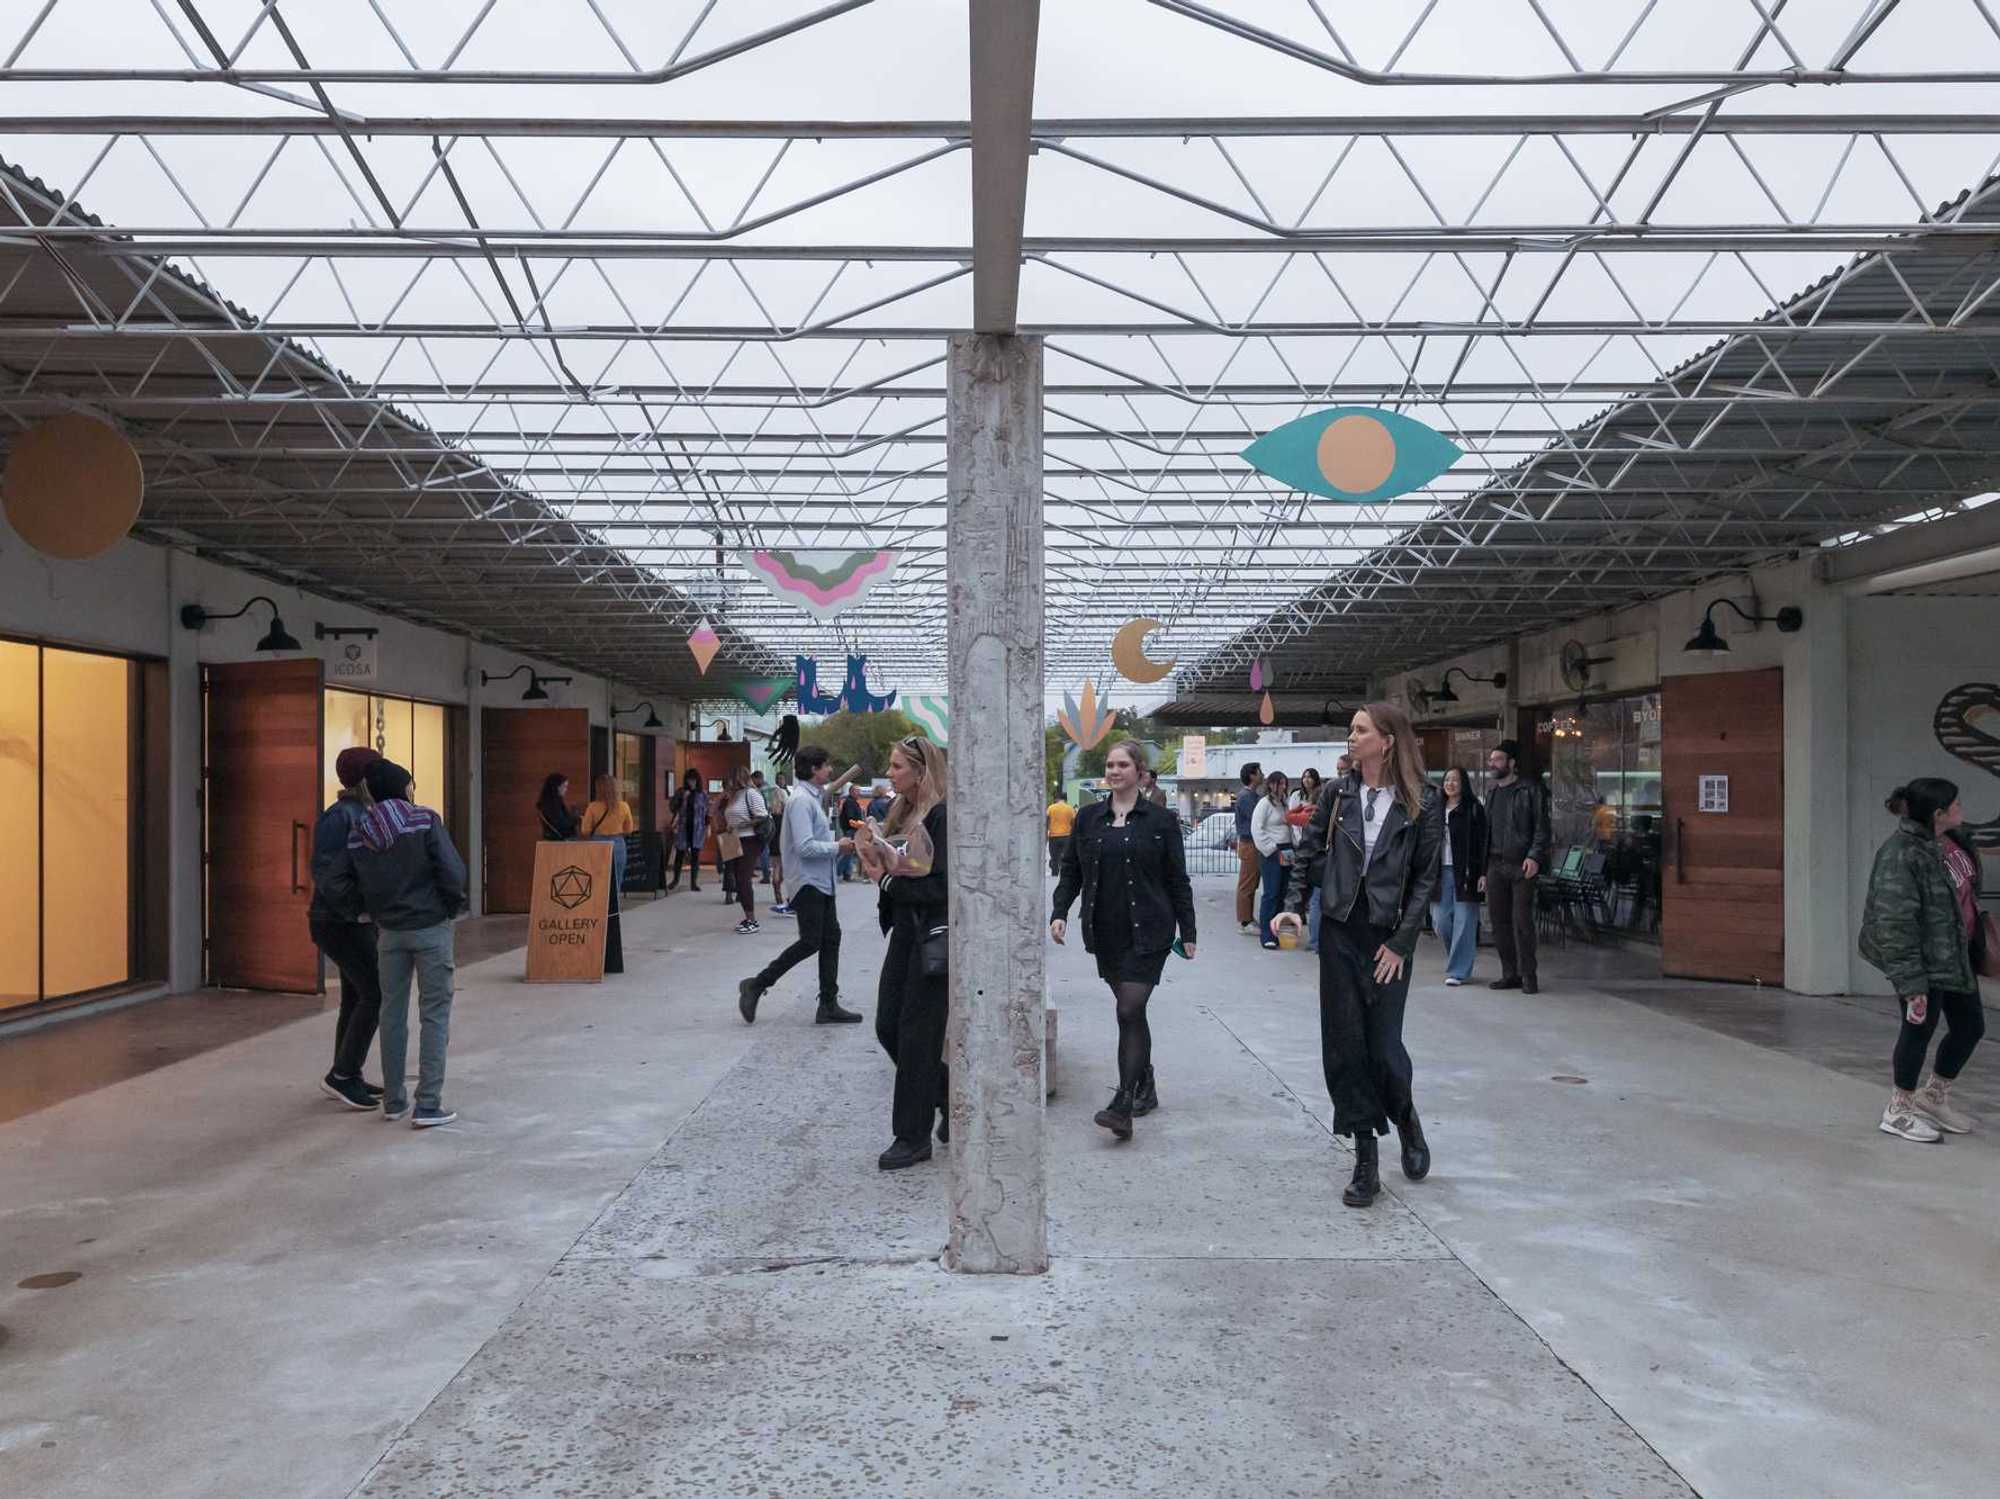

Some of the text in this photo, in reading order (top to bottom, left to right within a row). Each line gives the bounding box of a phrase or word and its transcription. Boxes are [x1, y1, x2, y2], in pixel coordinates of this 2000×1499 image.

[334, 663, 371, 675] ICOSA
[538, 918, 598, 930] GALLERY
[548, 934, 585, 945] OPEN
